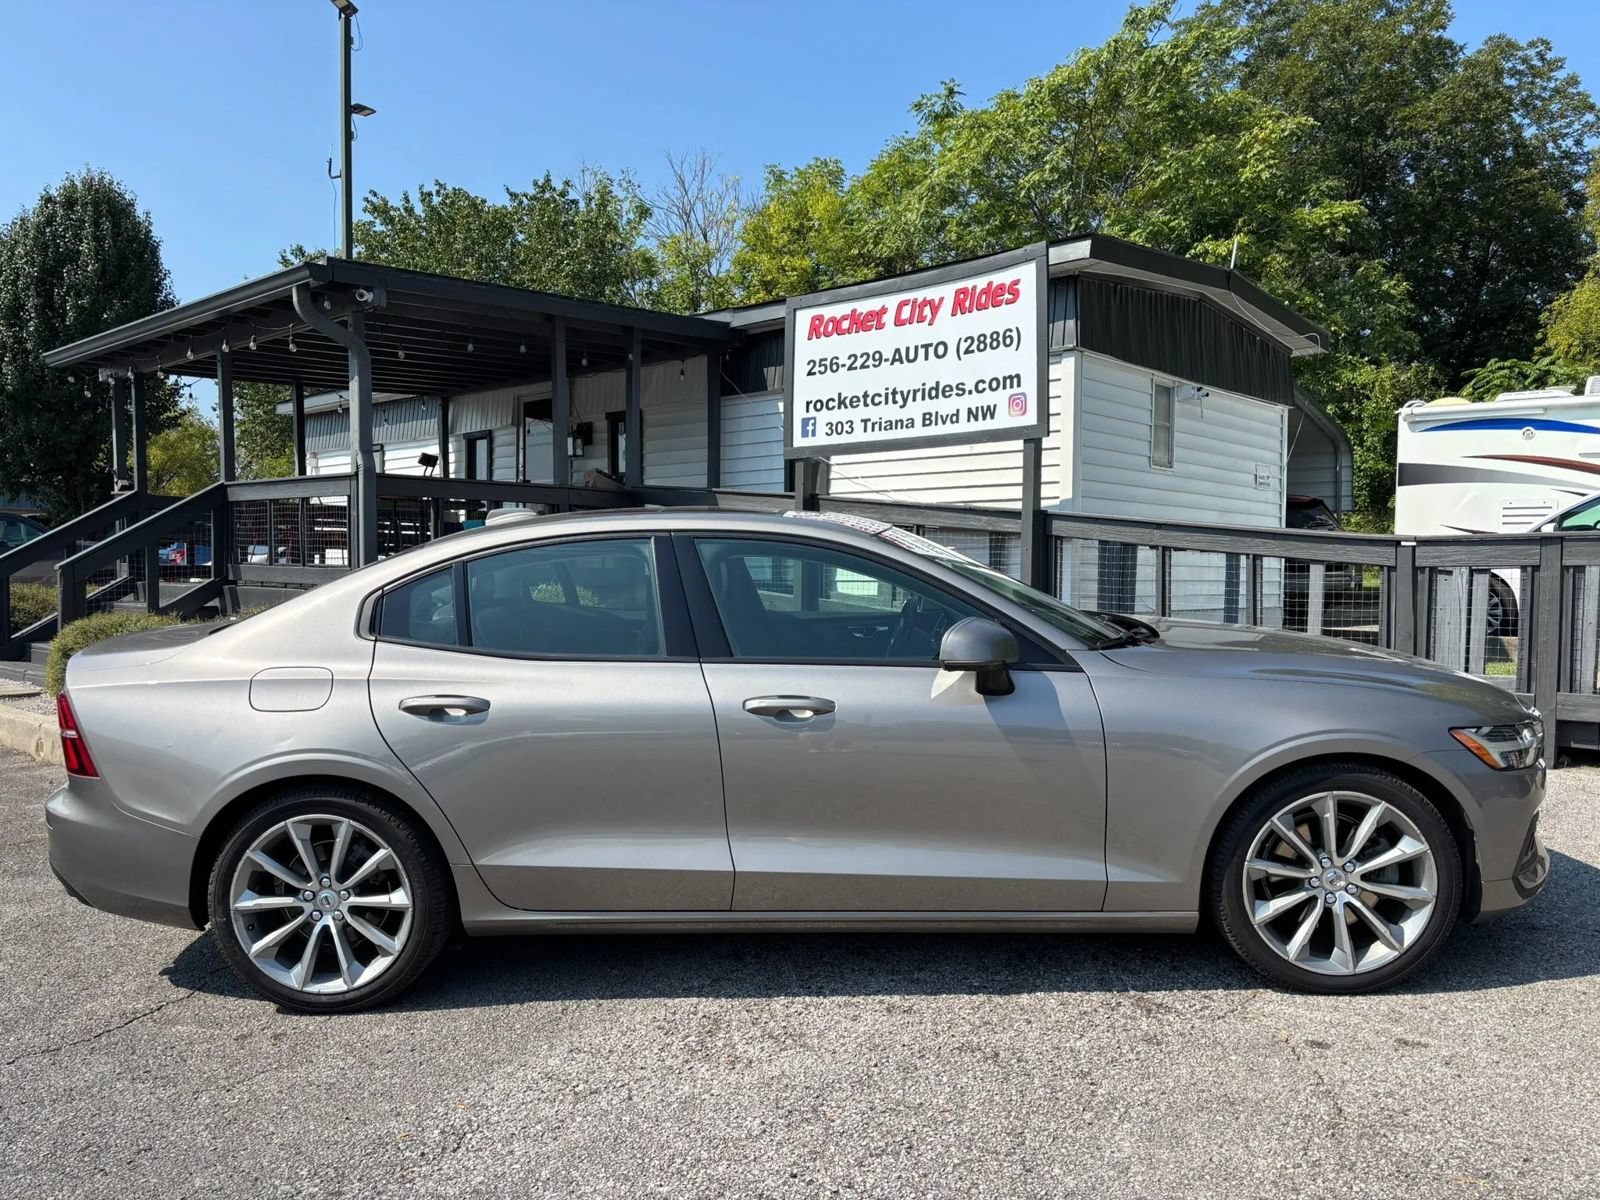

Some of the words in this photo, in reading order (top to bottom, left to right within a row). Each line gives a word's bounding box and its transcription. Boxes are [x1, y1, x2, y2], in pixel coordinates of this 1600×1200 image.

[807, 305, 889, 340] Rocket
[894, 296, 945, 326] City
[951, 279, 1021, 317] Rides
[806, 340, 948, 377] 256-229-AUTO
[956, 326, 1022, 361] (2886)
[805, 373, 1022, 413] rocketcityrides.com
[825, 419, 854, 437] 303
[861, 415, 915, 433] Triana
[921, 409, 960, 427] Blvd
[967, 404, 998, 423] NW
